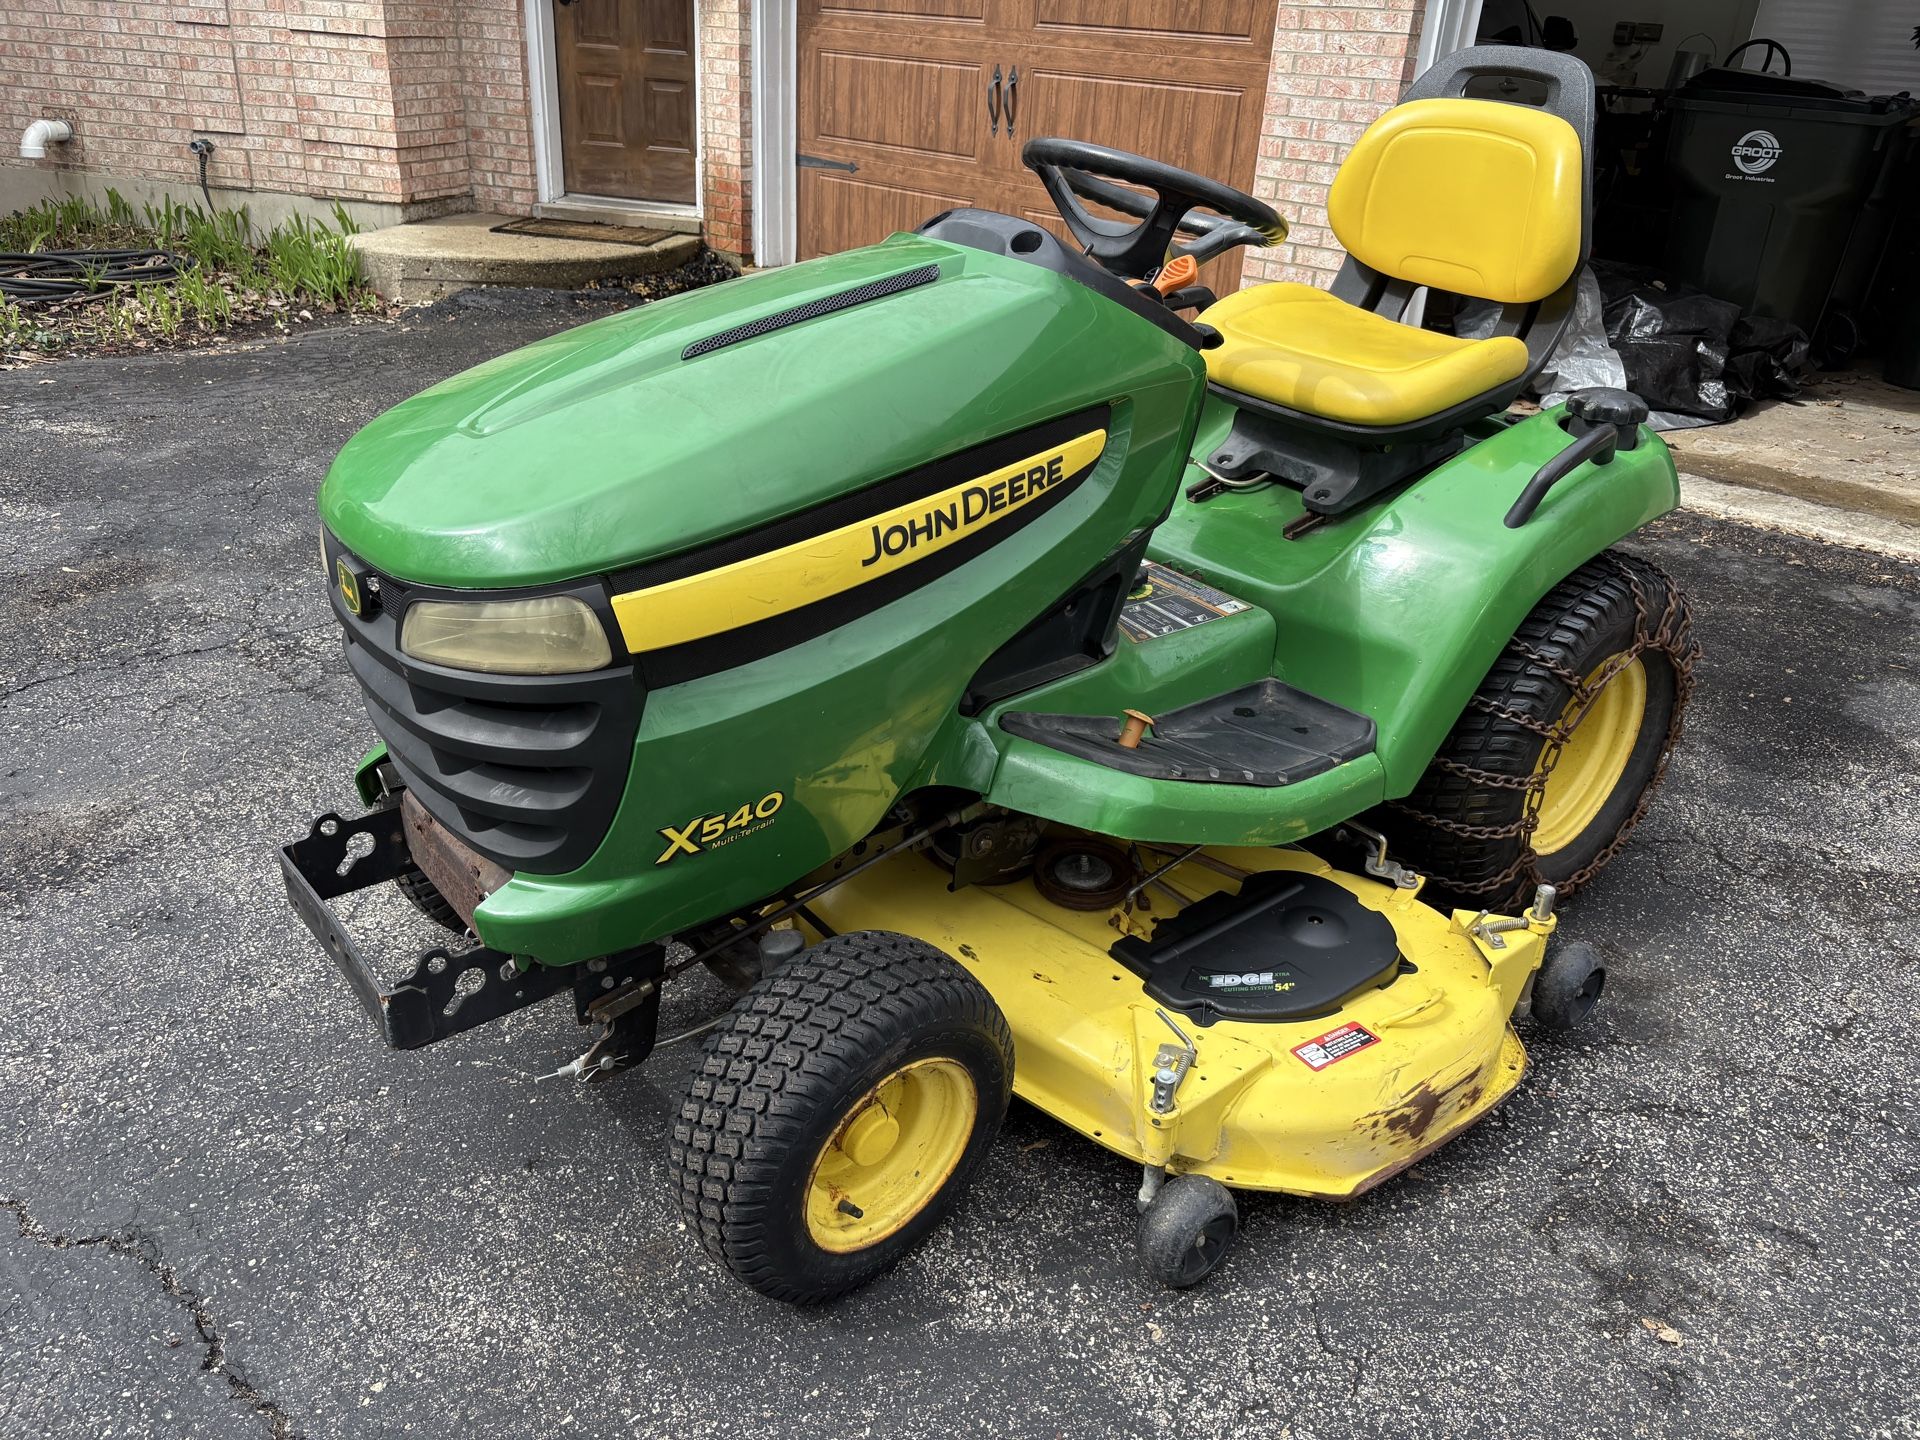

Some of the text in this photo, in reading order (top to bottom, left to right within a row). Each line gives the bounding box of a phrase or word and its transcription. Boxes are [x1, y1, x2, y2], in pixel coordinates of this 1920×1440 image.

[1731, 146, 1783, 159] GROOT
[1744, 175, 1775, 183] Industries
[862, 455, 1064, 567] JOHN DEERE
[654, 791, 784, 865] X540
[711, 818, 775, 850] Multi-Terrain
[1209, 972, 1276, 988] EDGE
[1274, 982, 1295, 992] 54"
